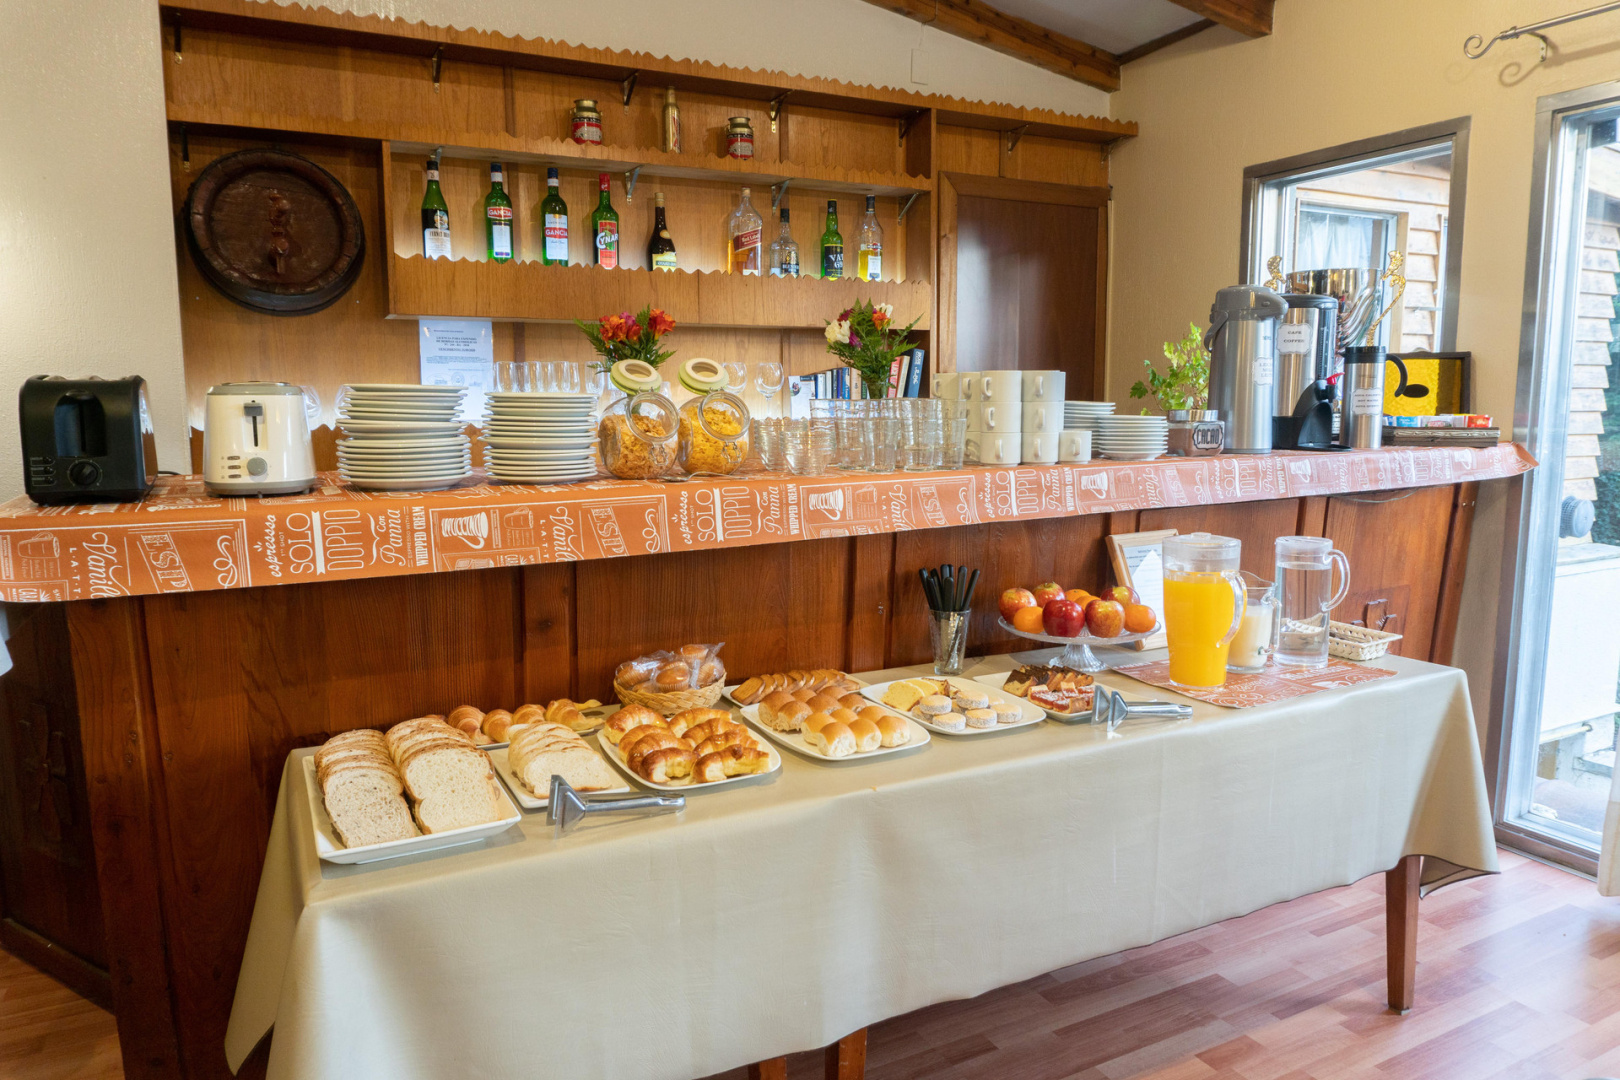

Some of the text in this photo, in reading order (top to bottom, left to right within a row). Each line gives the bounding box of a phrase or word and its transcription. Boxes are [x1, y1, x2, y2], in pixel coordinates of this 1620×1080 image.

[488, 209, 512, 217] GANCIA
[1197, 428, 1220, 445] CACAO
[995, 470, 1012, 516] SOLO
[1015, 468, 1040, 514] DOPPIO
[1047, 468, 1061, 512] Panna
[1222, 458, 1236, 497] SOLO
[1237, 457, 1257, 496] DOPPIO
[376, 515, 387, 532] Con
[695, 489, 716, 542] SOLO
[722, 486, 752, 539] DOPPIO
[763, 485, 783, 535] Panna
[786, 483, 800, 536] WHIPPED CREAM
[286, 512, 315, 574] SOLO
[323, 508, 365, 571] DOPPIO
[379, 508, 407, 567] Panna
[411, 506, 430, 567] WHIPPED CREAM
